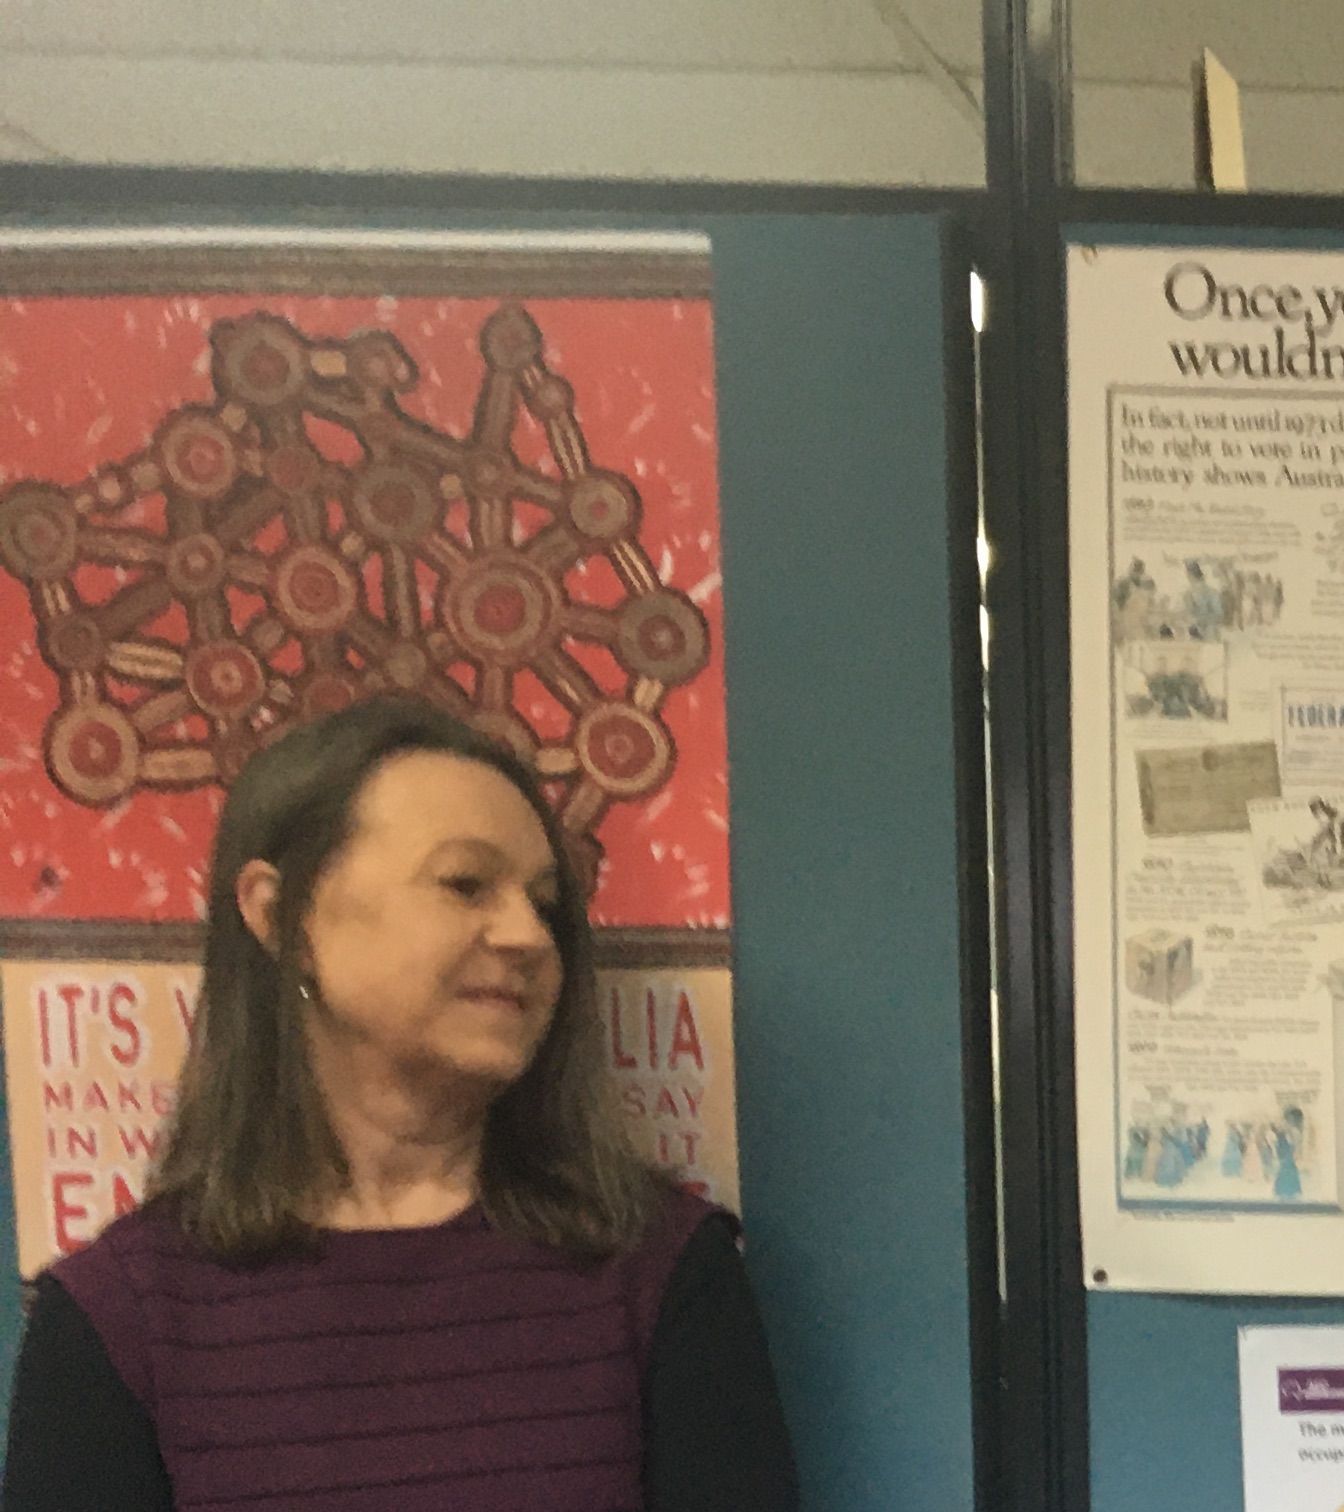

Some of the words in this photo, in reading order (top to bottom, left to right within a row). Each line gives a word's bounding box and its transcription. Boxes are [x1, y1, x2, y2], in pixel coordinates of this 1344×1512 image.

[1121, 402, 1145, 427] In
[1193, 411, 1227, 431] not
[1232, 408, 1281, 432] until
[1121, 431, 1154, 454] the
[1162, 432, 1212, 461] right
[1221, 437, 1243, 457] to
[1250, 440, 1293, 460] vote
[1300, 441, 1321, 460] in
[1121, 458, 1194, 491] history
[1202, 461, 1267, 486] shows
[38, 982, 141, 1068] IT'S
[43, 1080, 176, 1117] MAKE
[622, 1082, 706, 1121] SAY
[48, 1126, 98, 1160] IN
[657, 1130, 704, 1167] IT
[1298, 1420, 1328, 1437] The
